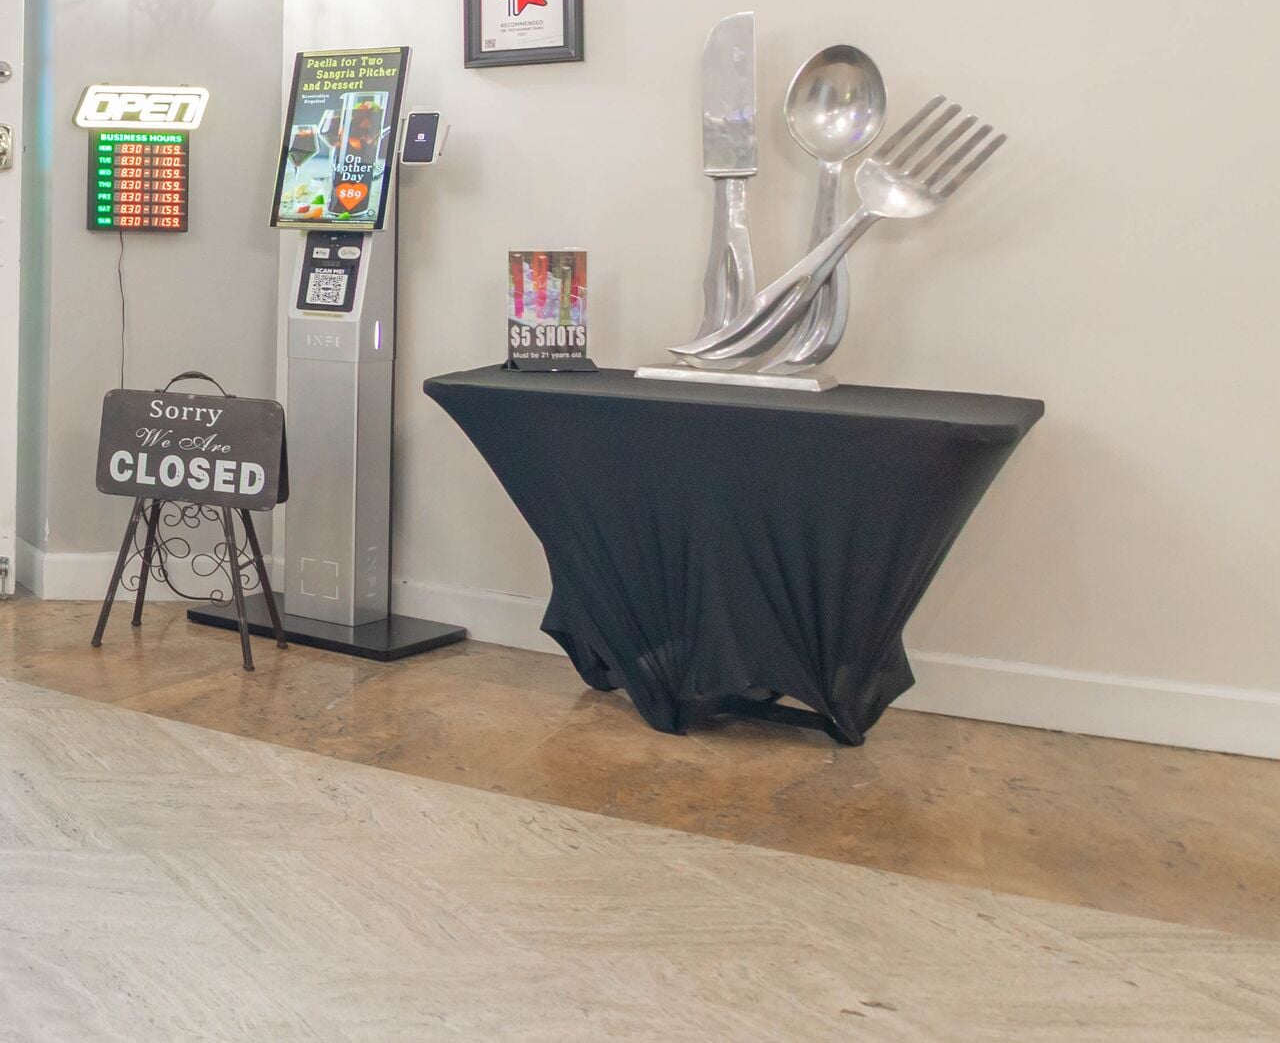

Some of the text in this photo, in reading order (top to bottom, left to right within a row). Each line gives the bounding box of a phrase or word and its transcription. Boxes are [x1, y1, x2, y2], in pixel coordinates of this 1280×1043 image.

[306, 56, 384, 68] Paella for Two
[316, 67, 397, 80] Sangria Pitcher
[302, 80, 364, 91] and Dessert
[100, 133, 183, 143] BUSINESS HOURS
[345, 154, 362, 164] On
[330, 163, 384, 173] Mother's
[341, 172, 364, 183] Day
[339, 188, 362, 199] $89
[510, 324, 586, 348] $5 SHOTS
[541, 351, 549, 359] 21
[551, 352, 570, 360] years
[149, 399, 224, 427] Sorry
[135, 427, 232, 453] We Are
[109, 449, 266, 496] CLOSED
